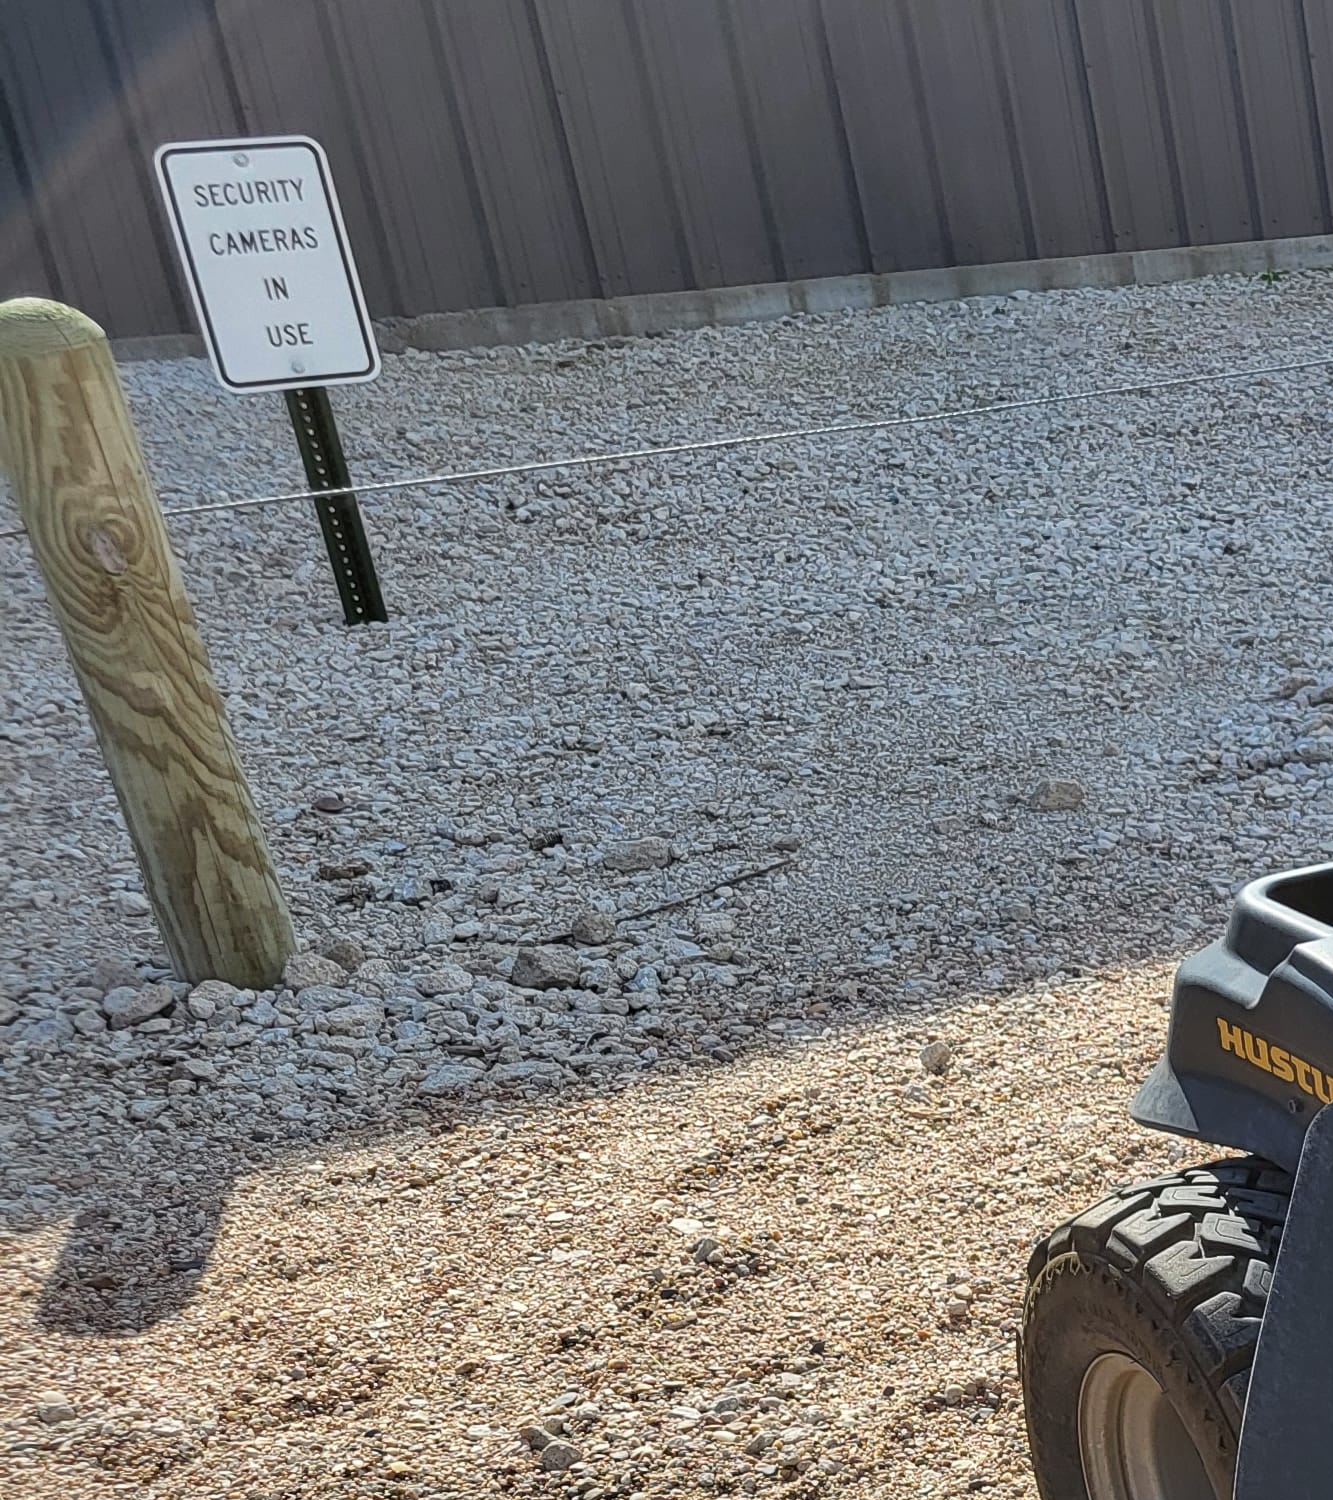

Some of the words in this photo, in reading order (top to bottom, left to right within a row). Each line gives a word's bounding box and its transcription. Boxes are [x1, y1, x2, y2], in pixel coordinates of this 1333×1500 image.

[194, 178, 304, 208] SECURITY
[210, 226, 319, 256] CAMERAS
[264, 276, 289, 301] IN
[266, 323, 314, 347] USE
